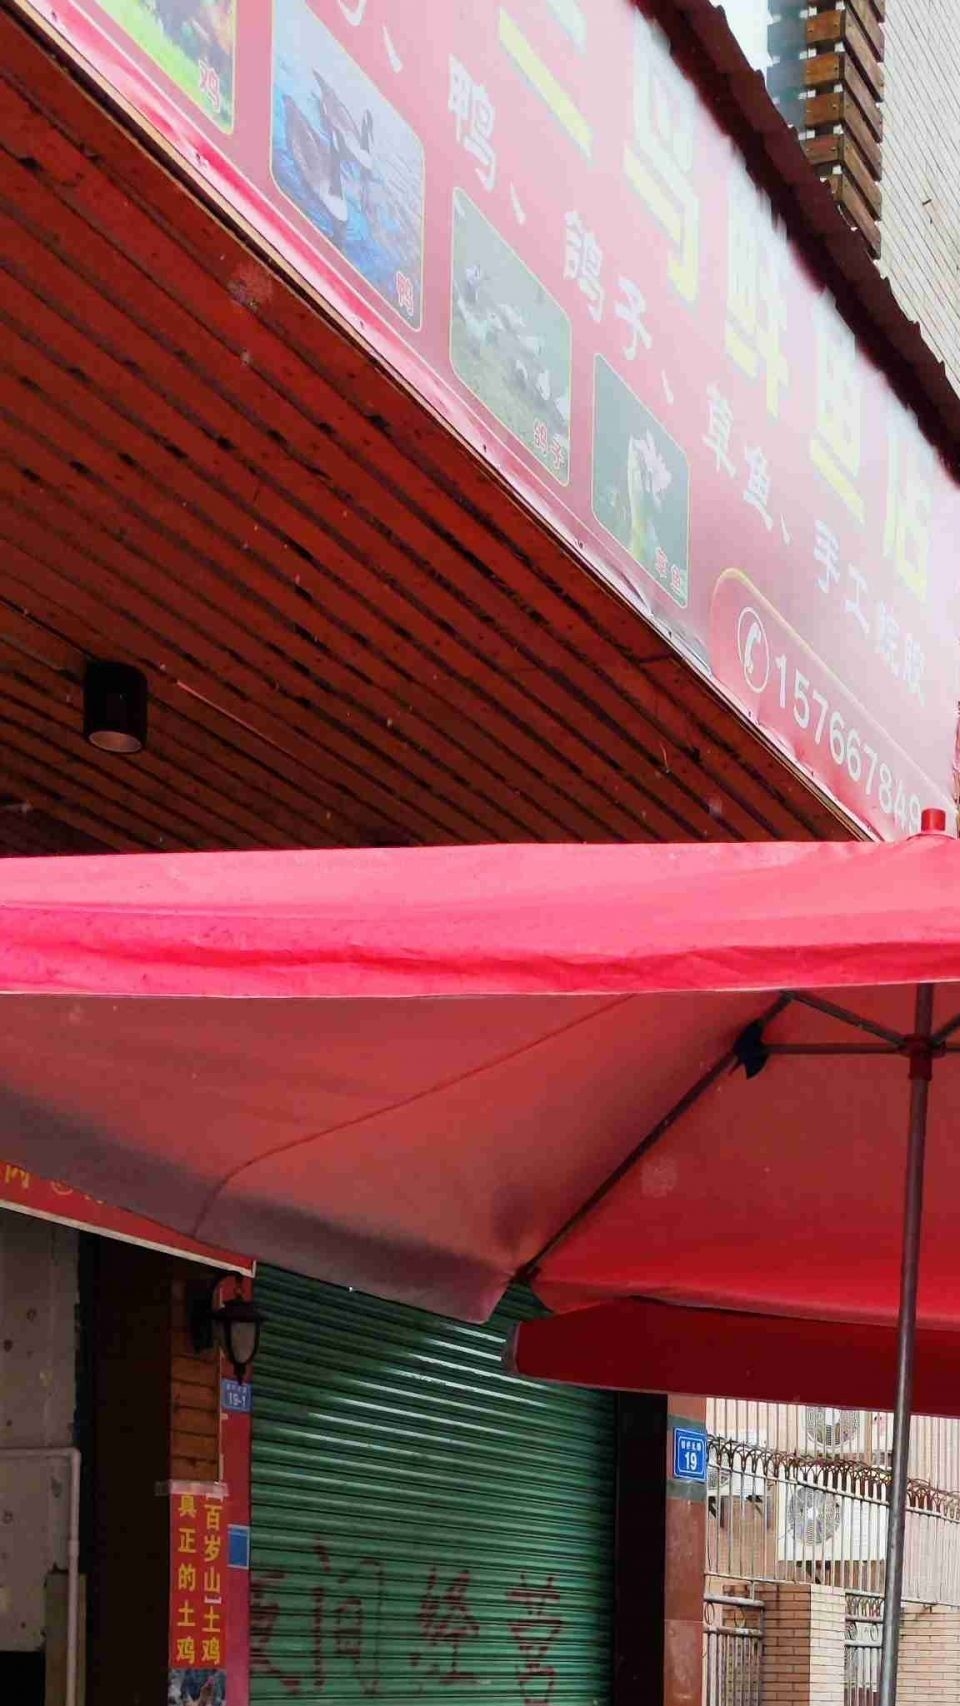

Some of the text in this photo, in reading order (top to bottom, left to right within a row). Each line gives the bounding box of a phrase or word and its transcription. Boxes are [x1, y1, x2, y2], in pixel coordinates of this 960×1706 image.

[684, 1451, 698, 1471] 19
[176, 1492, 198, 1666] 真正的土鸡
